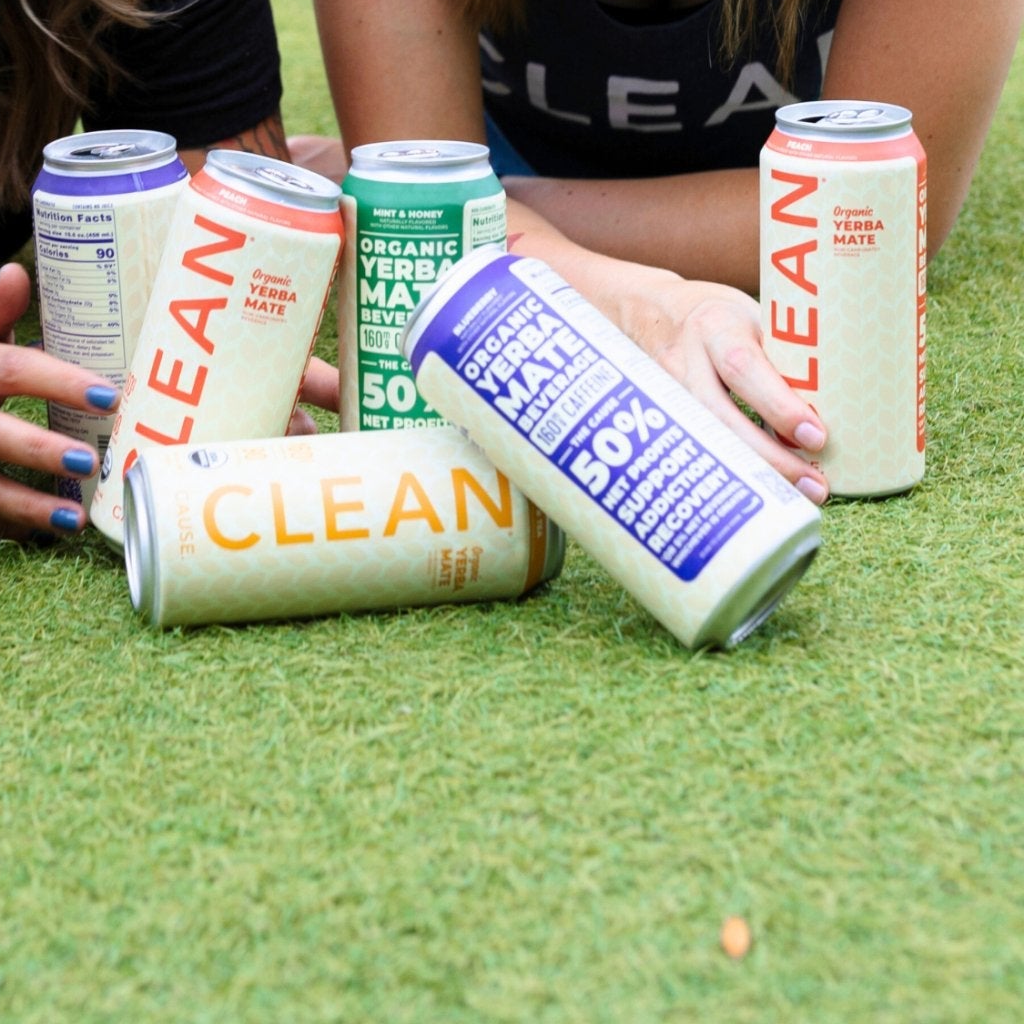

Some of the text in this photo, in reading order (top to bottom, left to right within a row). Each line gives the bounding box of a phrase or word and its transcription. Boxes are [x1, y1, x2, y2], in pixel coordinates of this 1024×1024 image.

[479, 31, 833, 131] LEA
[787, 140, 813, 152] PEACH
[36, 207, 112, 223] Nutrition Facts
[219, 189, 247, 205] PEACH
[373, 208, 443, 219] MINT & HONEY
[833, 205, 873, 219] Organic
[360, 238, 457, 256] ORGANIC
[833, 219, 884, 231] YERBA
[833, 234, 875, 245] MATE
[40, 244, 114, 259] Calories 90
[250, 282, 297, 303] YERBA
[252, 268, 291, 286] Organic
[244, 296, 286, 316] MATE
[451, 287, 498, 335] BLUEBERRY
[771, 169, 819, 448] LEAN
[461, 296, 542, 380] ORGANIC
[474, 308, 561, 397] YERBA
[379, 360, 398, 370] THE
[493, 325, 584, 418] MATE
[516, 347, 596, 430] BEVERAGE
[561, 365, 614, 419] CAFFEINE
[363, 414, 390, 428] NET
[565, 391, 668, 495] 50%
[571, 397, 618, 446] THE CAUSE
[601, 425, 682, 508] NET PROFITS
[615, 437, 699, 523] SUPPORT
[202, 467, 513, 551] CLEAN
[631, 452, 714, 537] ADDICTION
[647, 465, 729, 550] RECOVERY
[439, 548, 452, 587] MATE
[453, 546, 467, 593] YERBA
